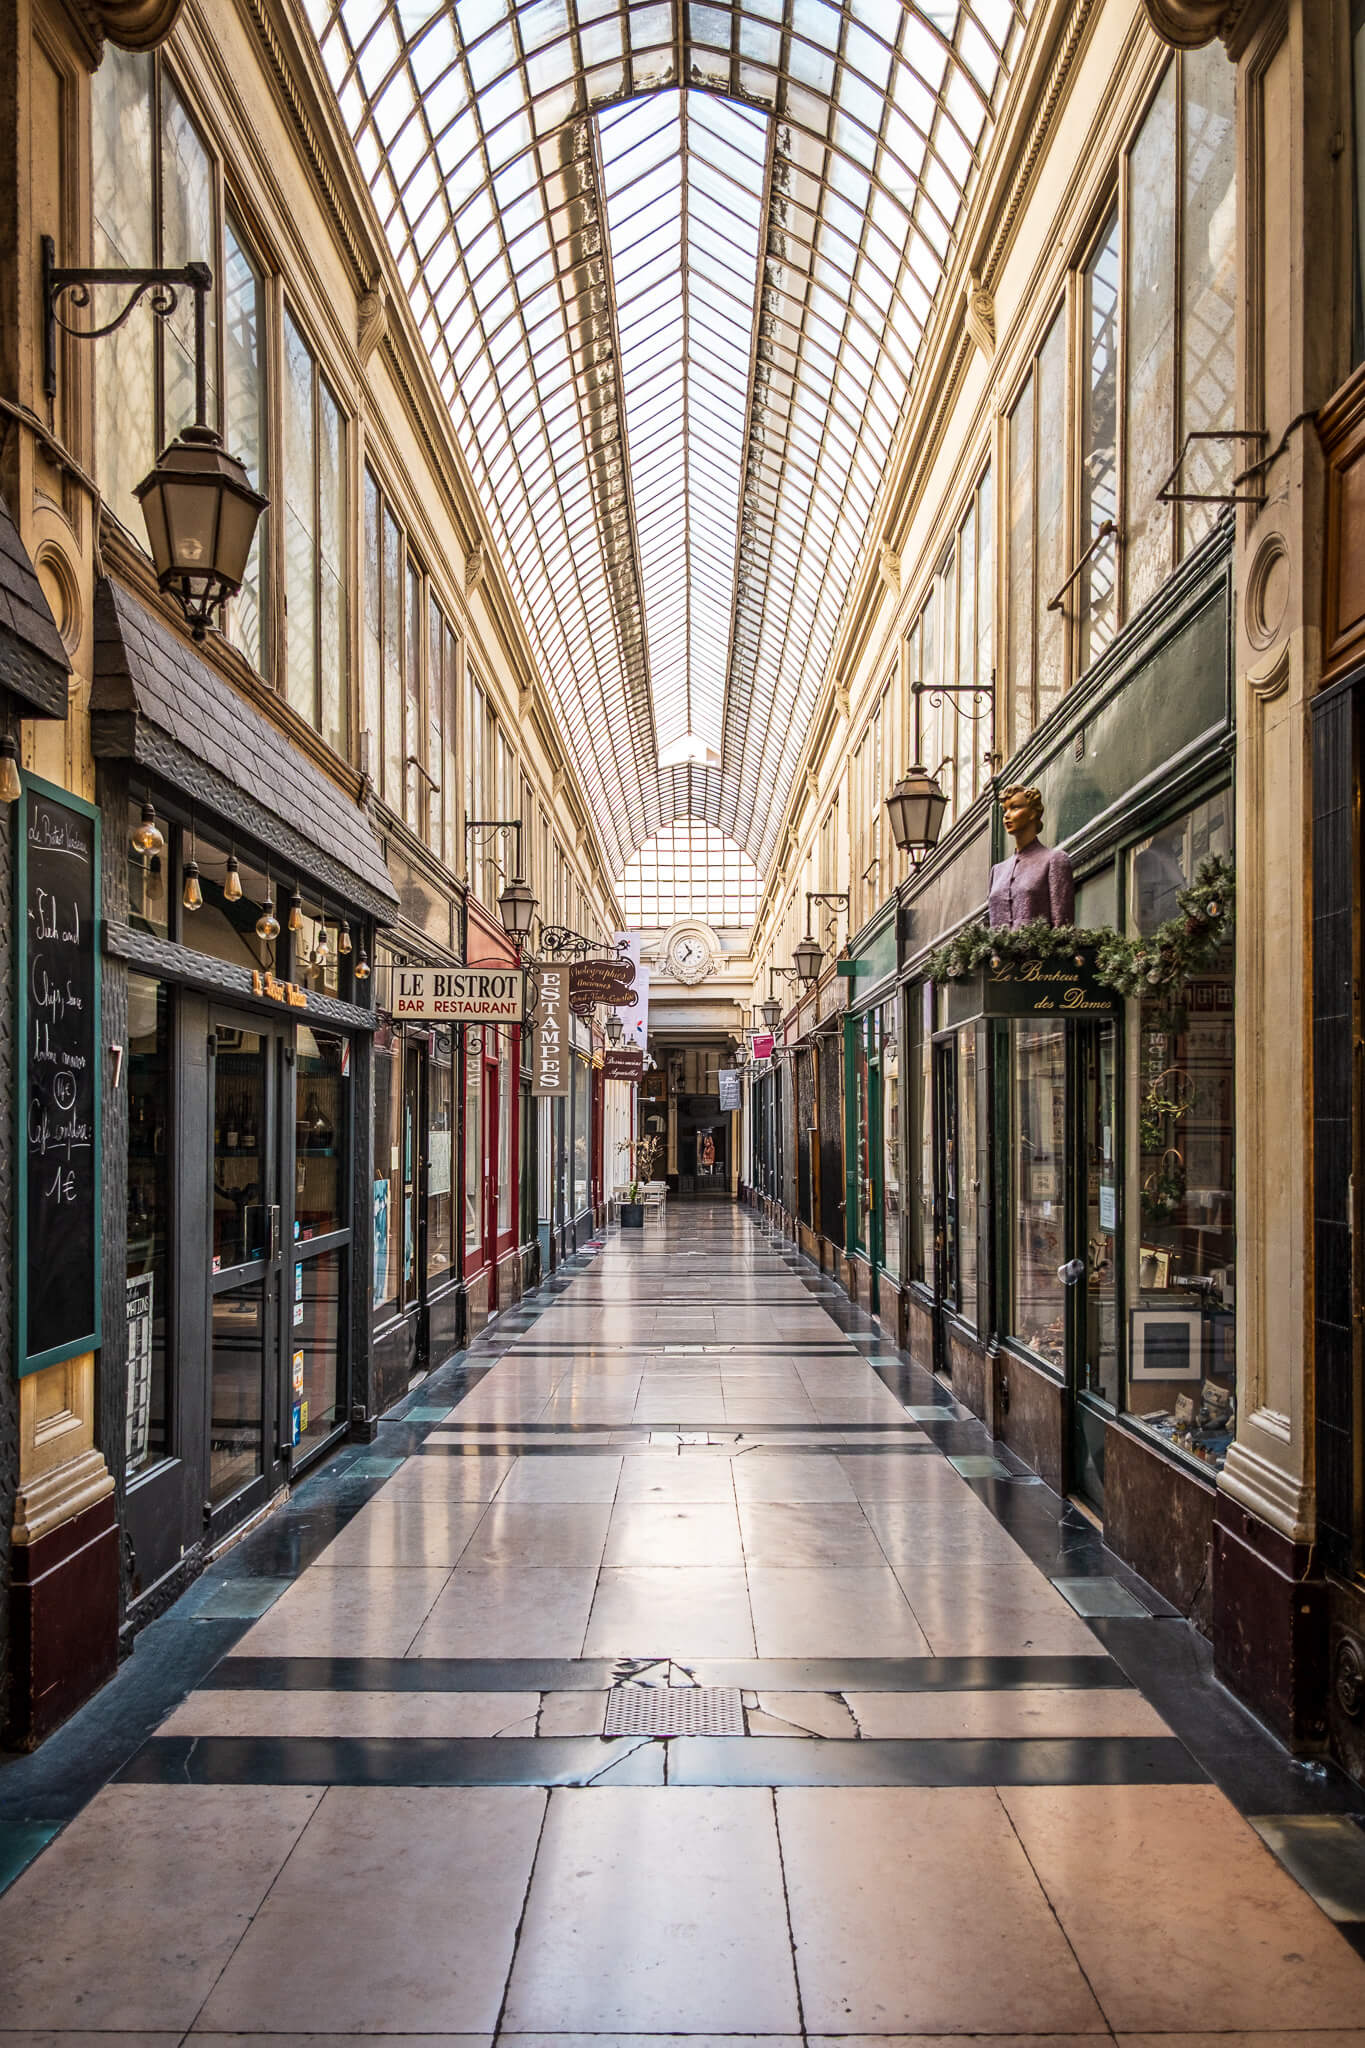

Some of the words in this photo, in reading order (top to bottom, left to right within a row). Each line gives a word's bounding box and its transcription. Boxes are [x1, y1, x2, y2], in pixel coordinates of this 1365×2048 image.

[989, 962, 1015, 982] Le
[1014, 960, 1080, 982] Bonheur
[399, 973, 425, 997] LE
[432, 974, 518, 999] BISTROT
[1033, 995, 1056, 1009] des
[1058, 987, 1113, 1009] Dames
[398, 999, 425, 1012] BAR
[434, 1000, 518, 1015] RESTAURANT
[539, 972, 561, 1088] ESTAMPES
[110, 1044, 123, 1088] 7
